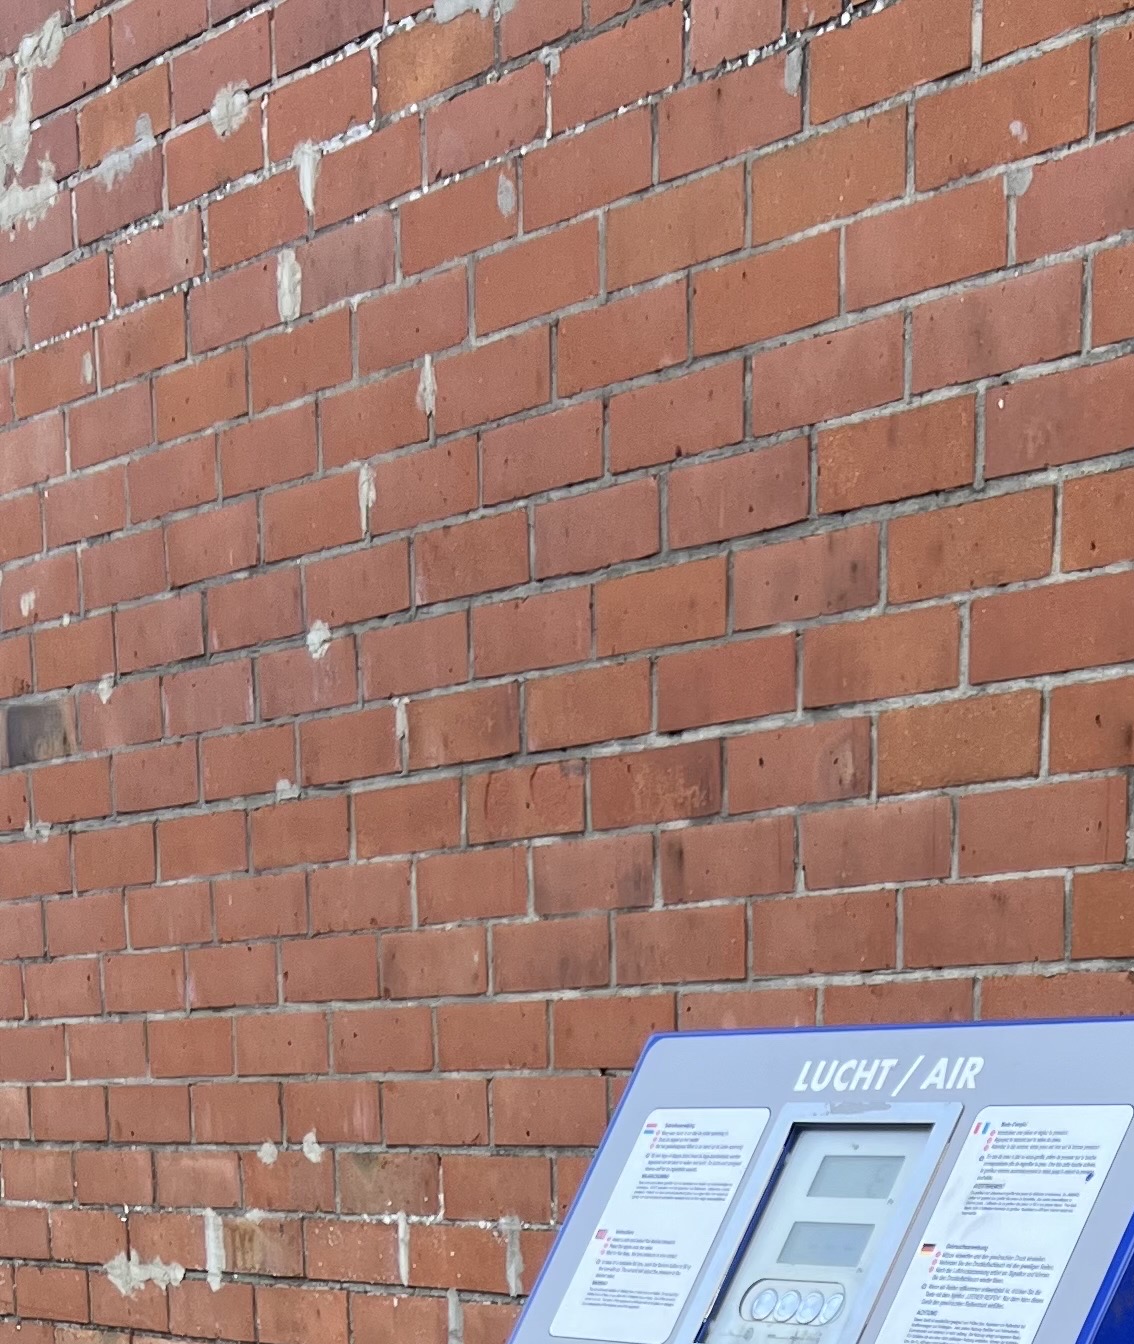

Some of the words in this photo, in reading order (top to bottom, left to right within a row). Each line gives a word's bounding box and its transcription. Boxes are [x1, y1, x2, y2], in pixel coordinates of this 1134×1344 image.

[793, 1057, 899, 1092] LUCHT
[890, 1054, 926, 1097] /
[919, 1056, 985, 1090] AIR
